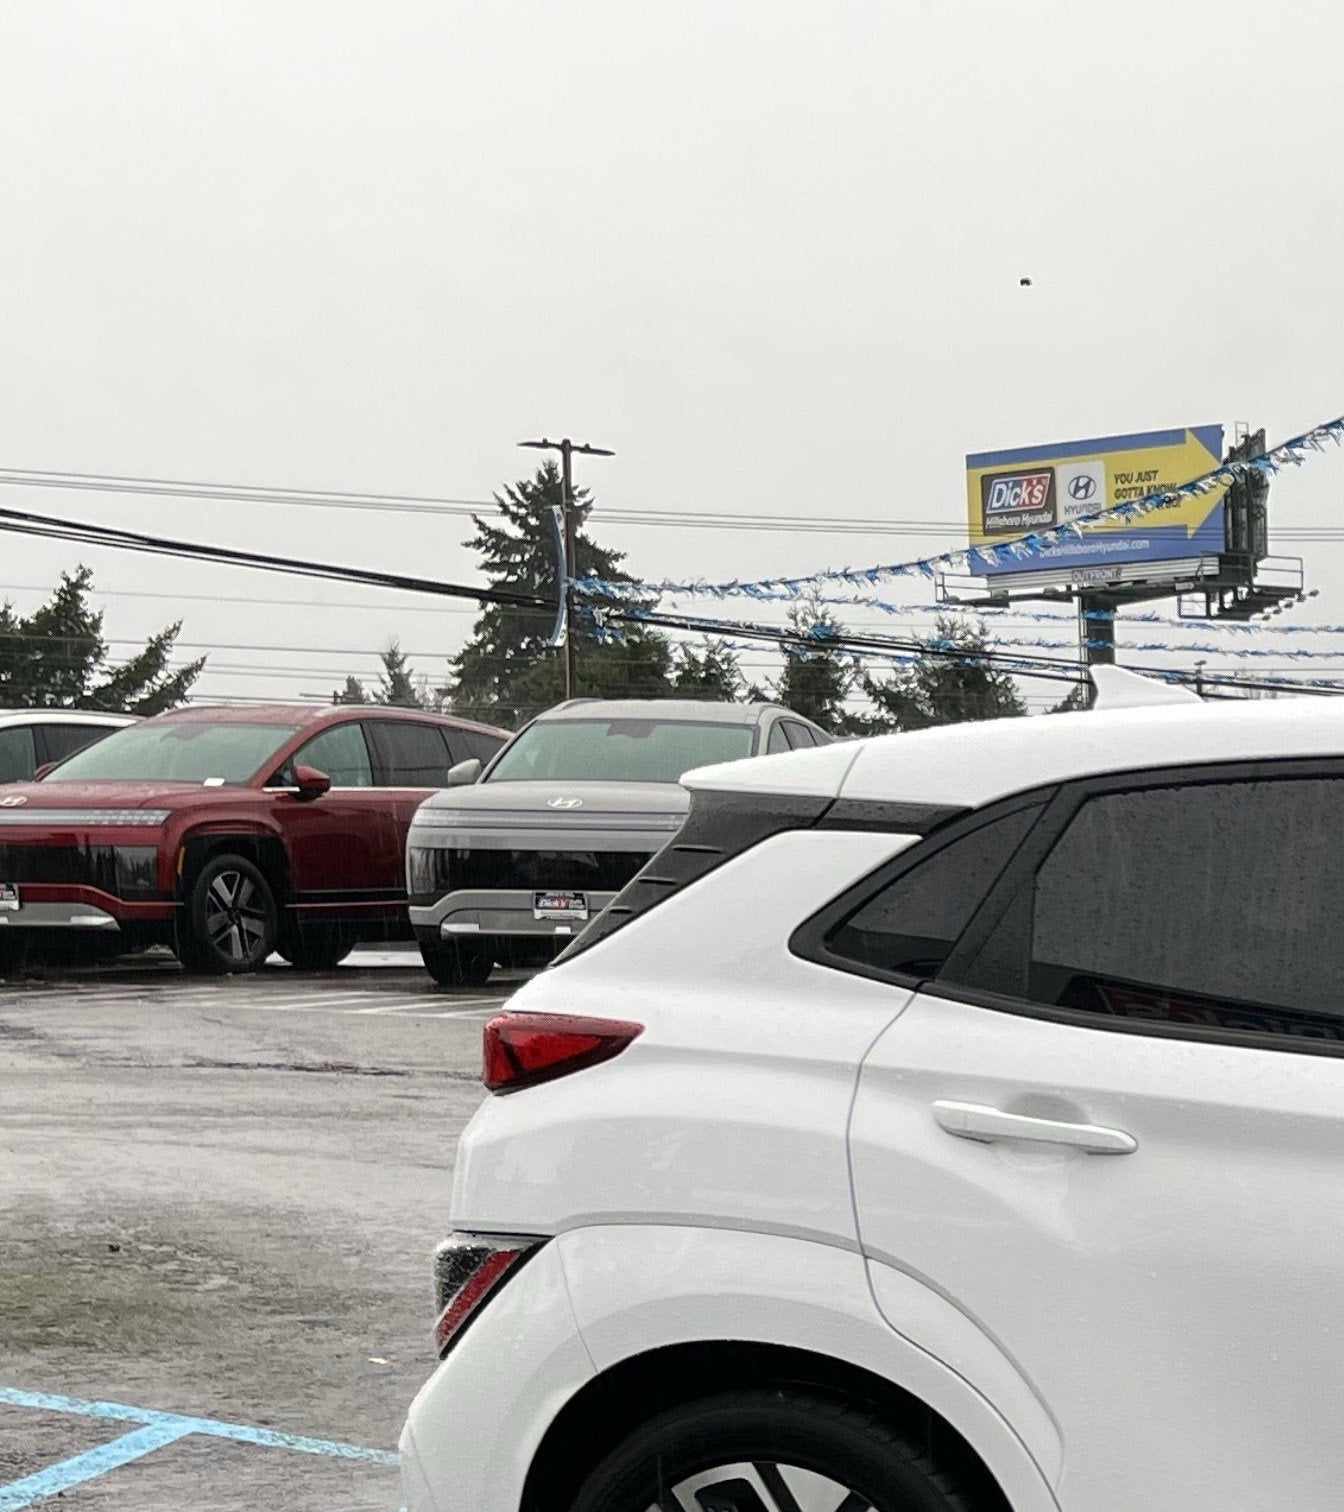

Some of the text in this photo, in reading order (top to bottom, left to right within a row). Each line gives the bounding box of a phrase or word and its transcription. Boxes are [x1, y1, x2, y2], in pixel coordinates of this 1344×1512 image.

[1114, 470, 1158, 484] YOU JUST
[992, 479, 1044, 508] Dick's
[1114, 486, 1144, 499] GOTTA
